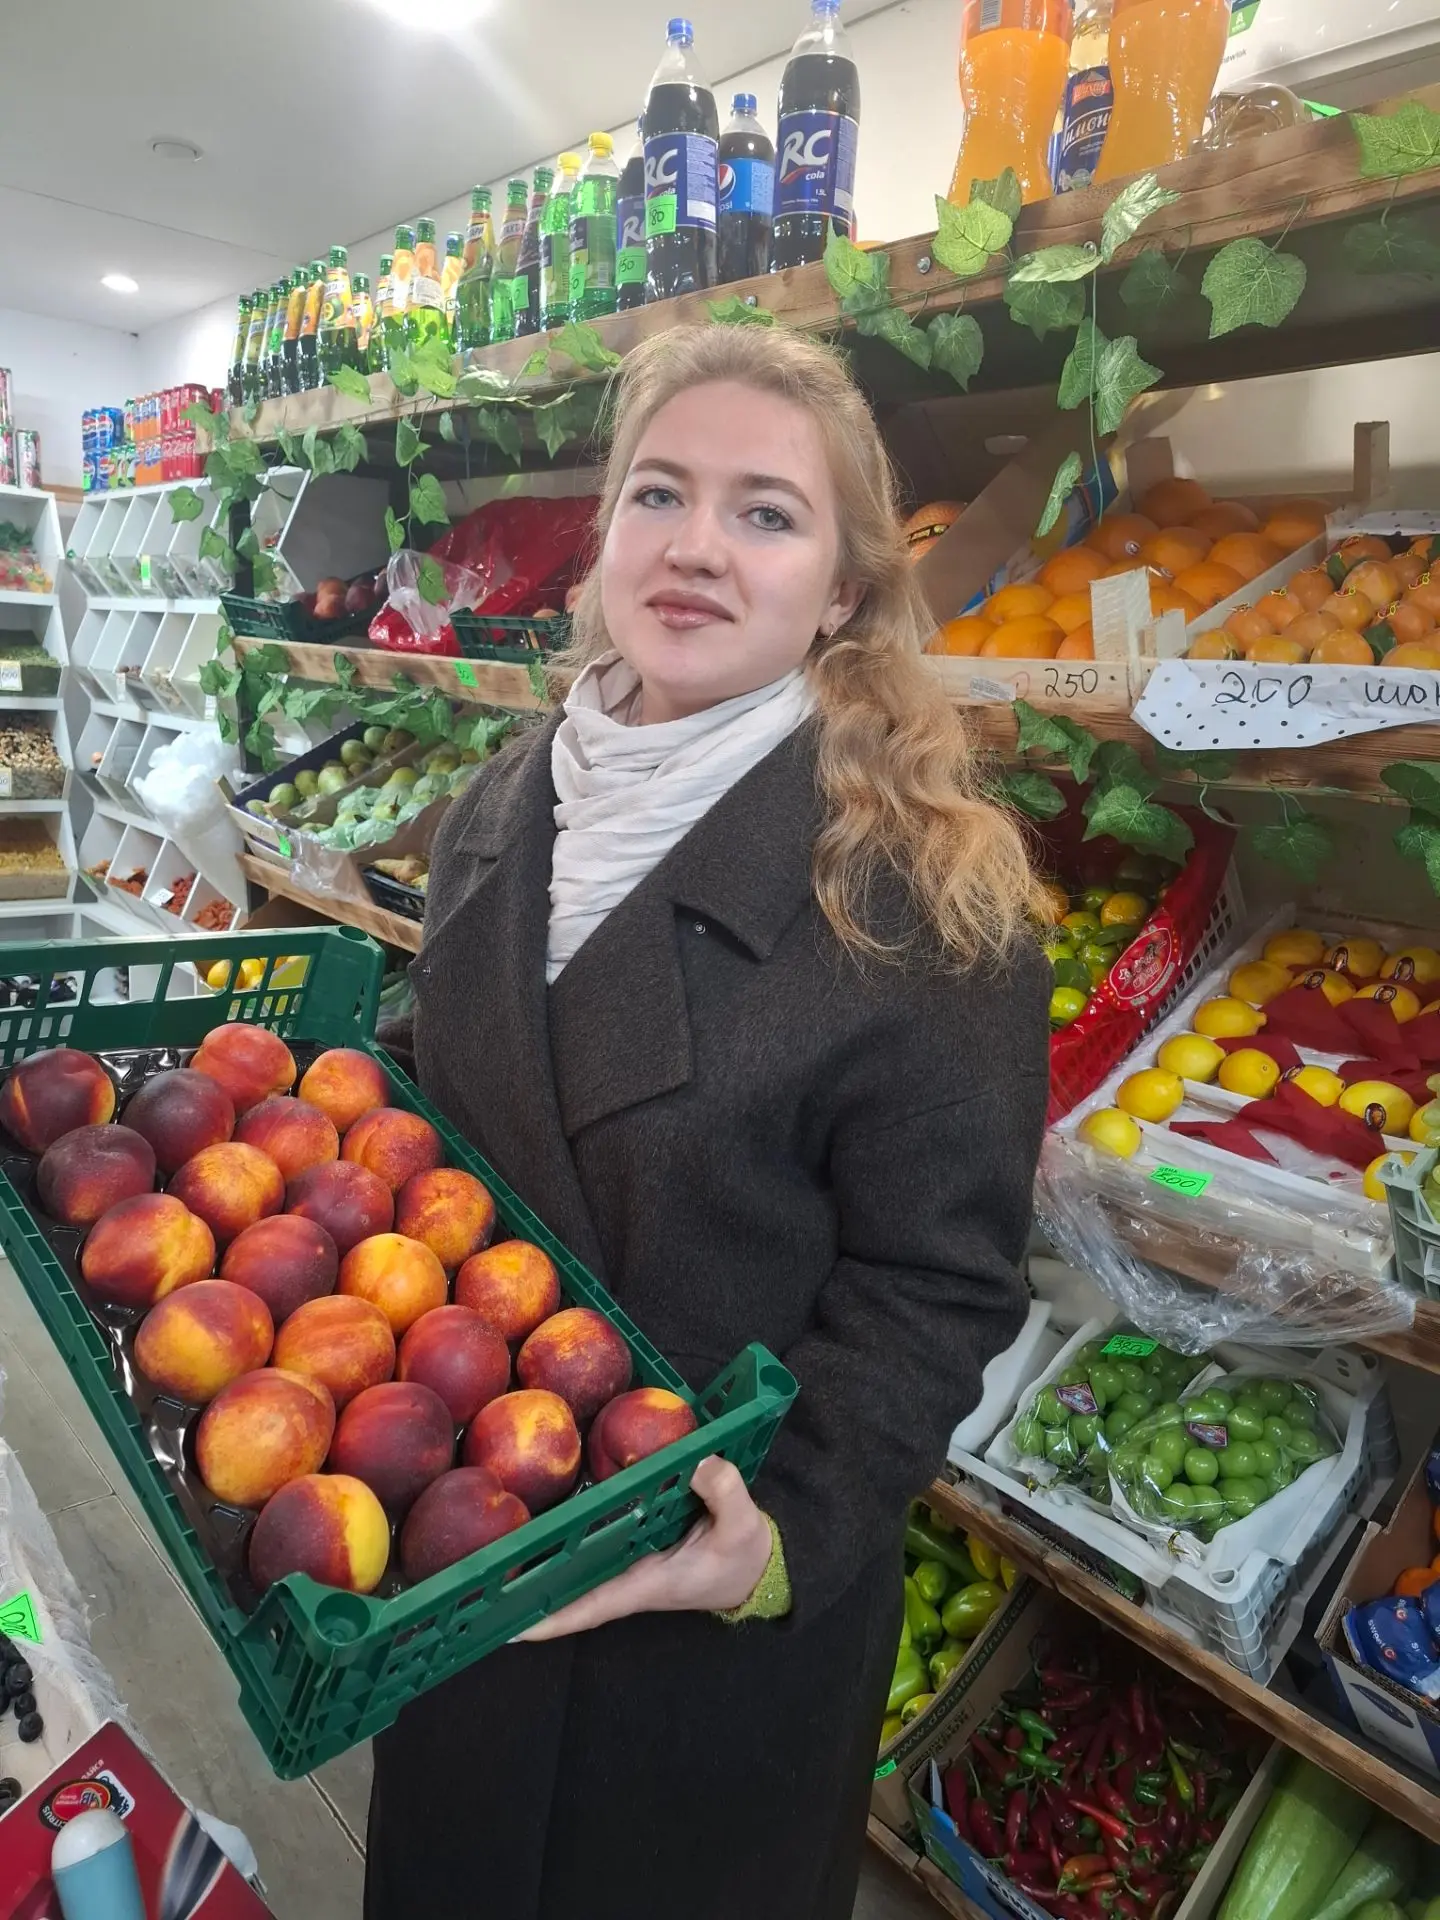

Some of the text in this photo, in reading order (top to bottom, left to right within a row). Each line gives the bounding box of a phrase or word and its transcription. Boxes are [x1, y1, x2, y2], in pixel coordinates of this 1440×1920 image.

[780, 129, 832, 184] RC
[805, 170, 825, 181] cola
[1043, 667, 1099, 699] 250
[1214, 671, 1314, 706] 200
[1156, 1173, 1197, 1188] 500
